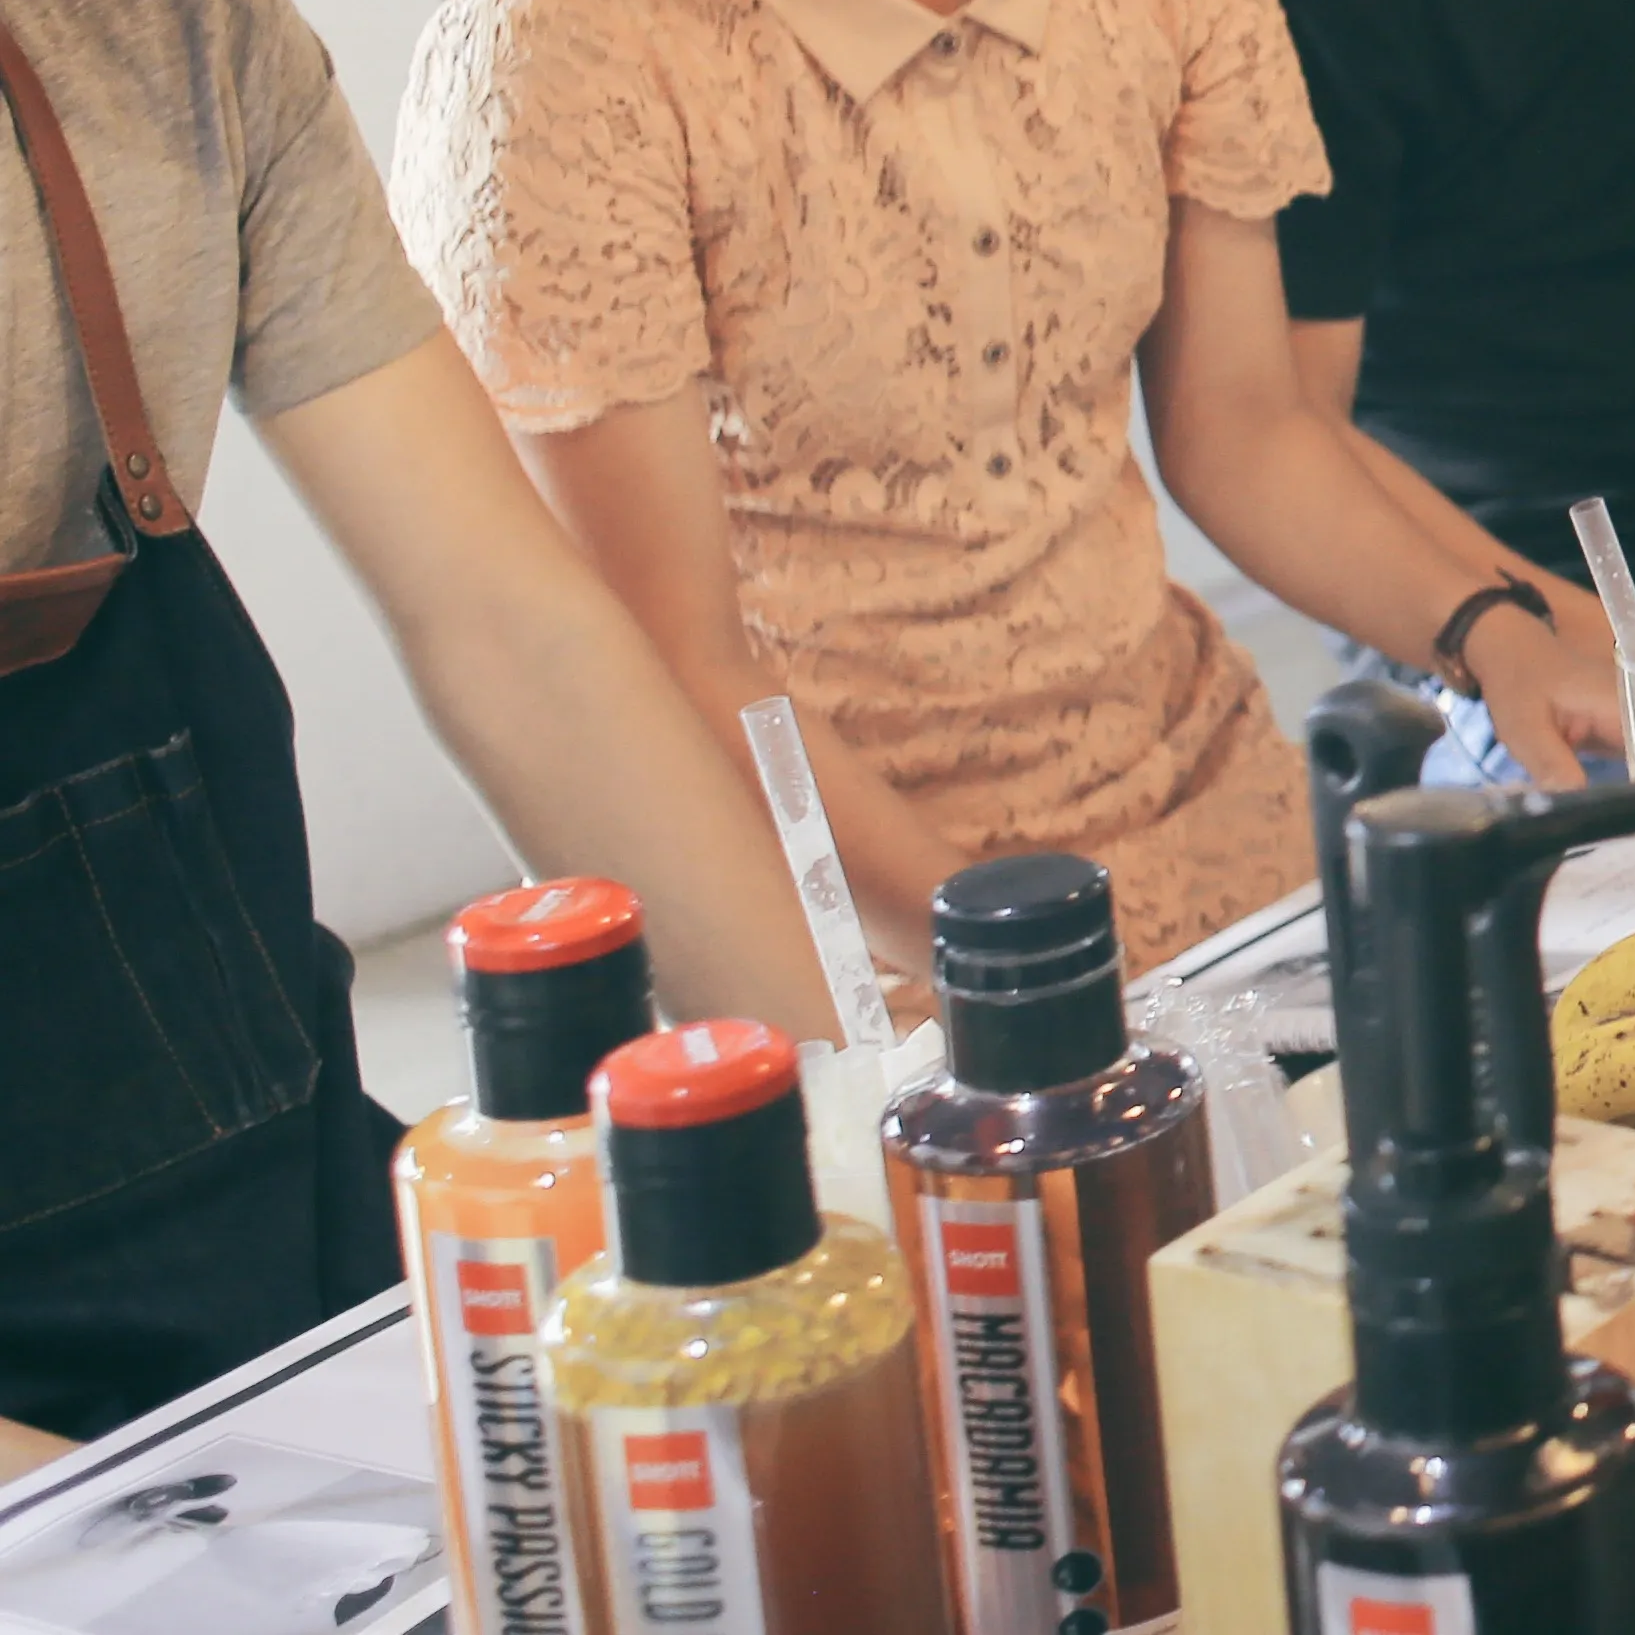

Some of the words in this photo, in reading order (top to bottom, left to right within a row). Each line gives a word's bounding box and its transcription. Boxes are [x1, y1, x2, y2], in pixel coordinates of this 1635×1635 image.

[469, 1348, 551, 1492] STICKY
[951, 1310, 1046, 1552] MACADAMIA
[636, 1527, 725, 1623] GOLD
